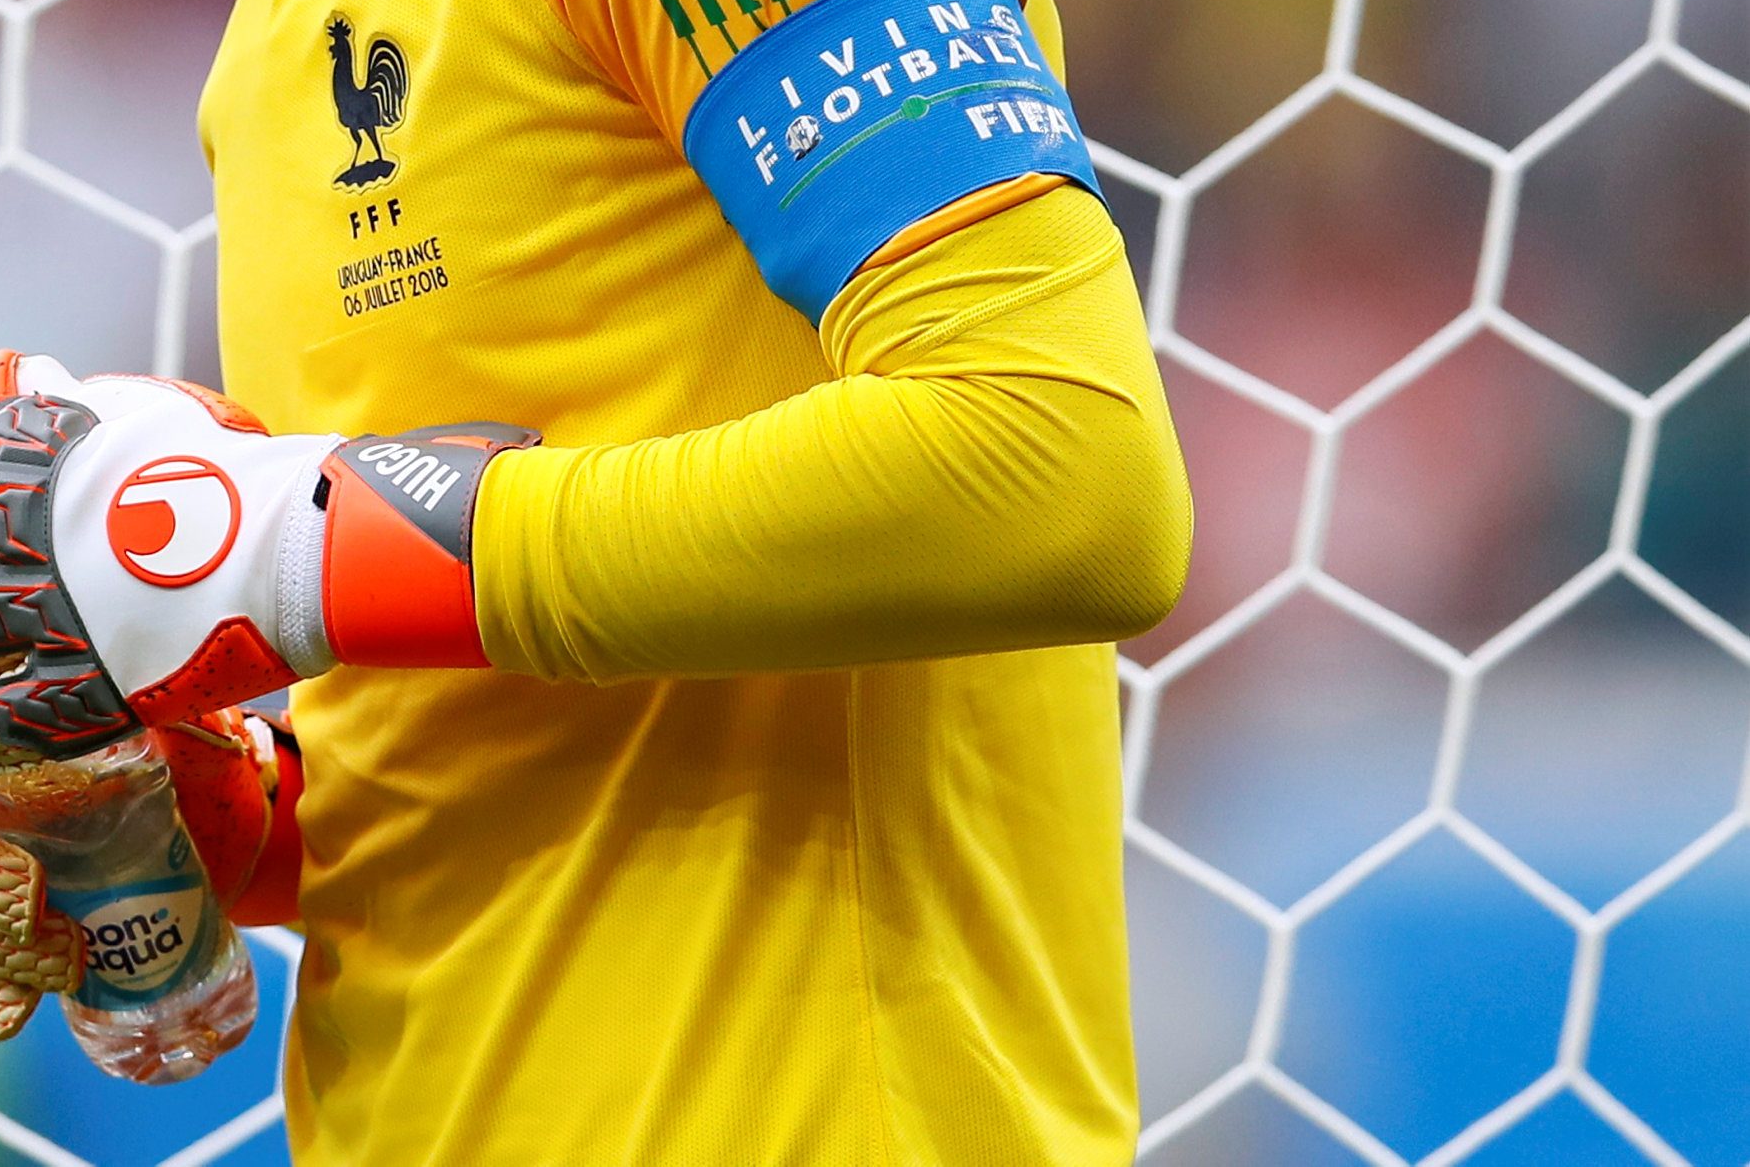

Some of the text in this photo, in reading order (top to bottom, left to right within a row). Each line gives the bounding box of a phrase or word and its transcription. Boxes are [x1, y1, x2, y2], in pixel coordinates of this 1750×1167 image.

[737, 1, 1023, 150] LIVING
[965, 99, 1078, 143] FIFA
[338, 237, 442, 290] URUGUAY-FRANCE
[344, 266, 448, 317] 06 JUILLET 2018
[357, 442, 462, 512] HUGO
